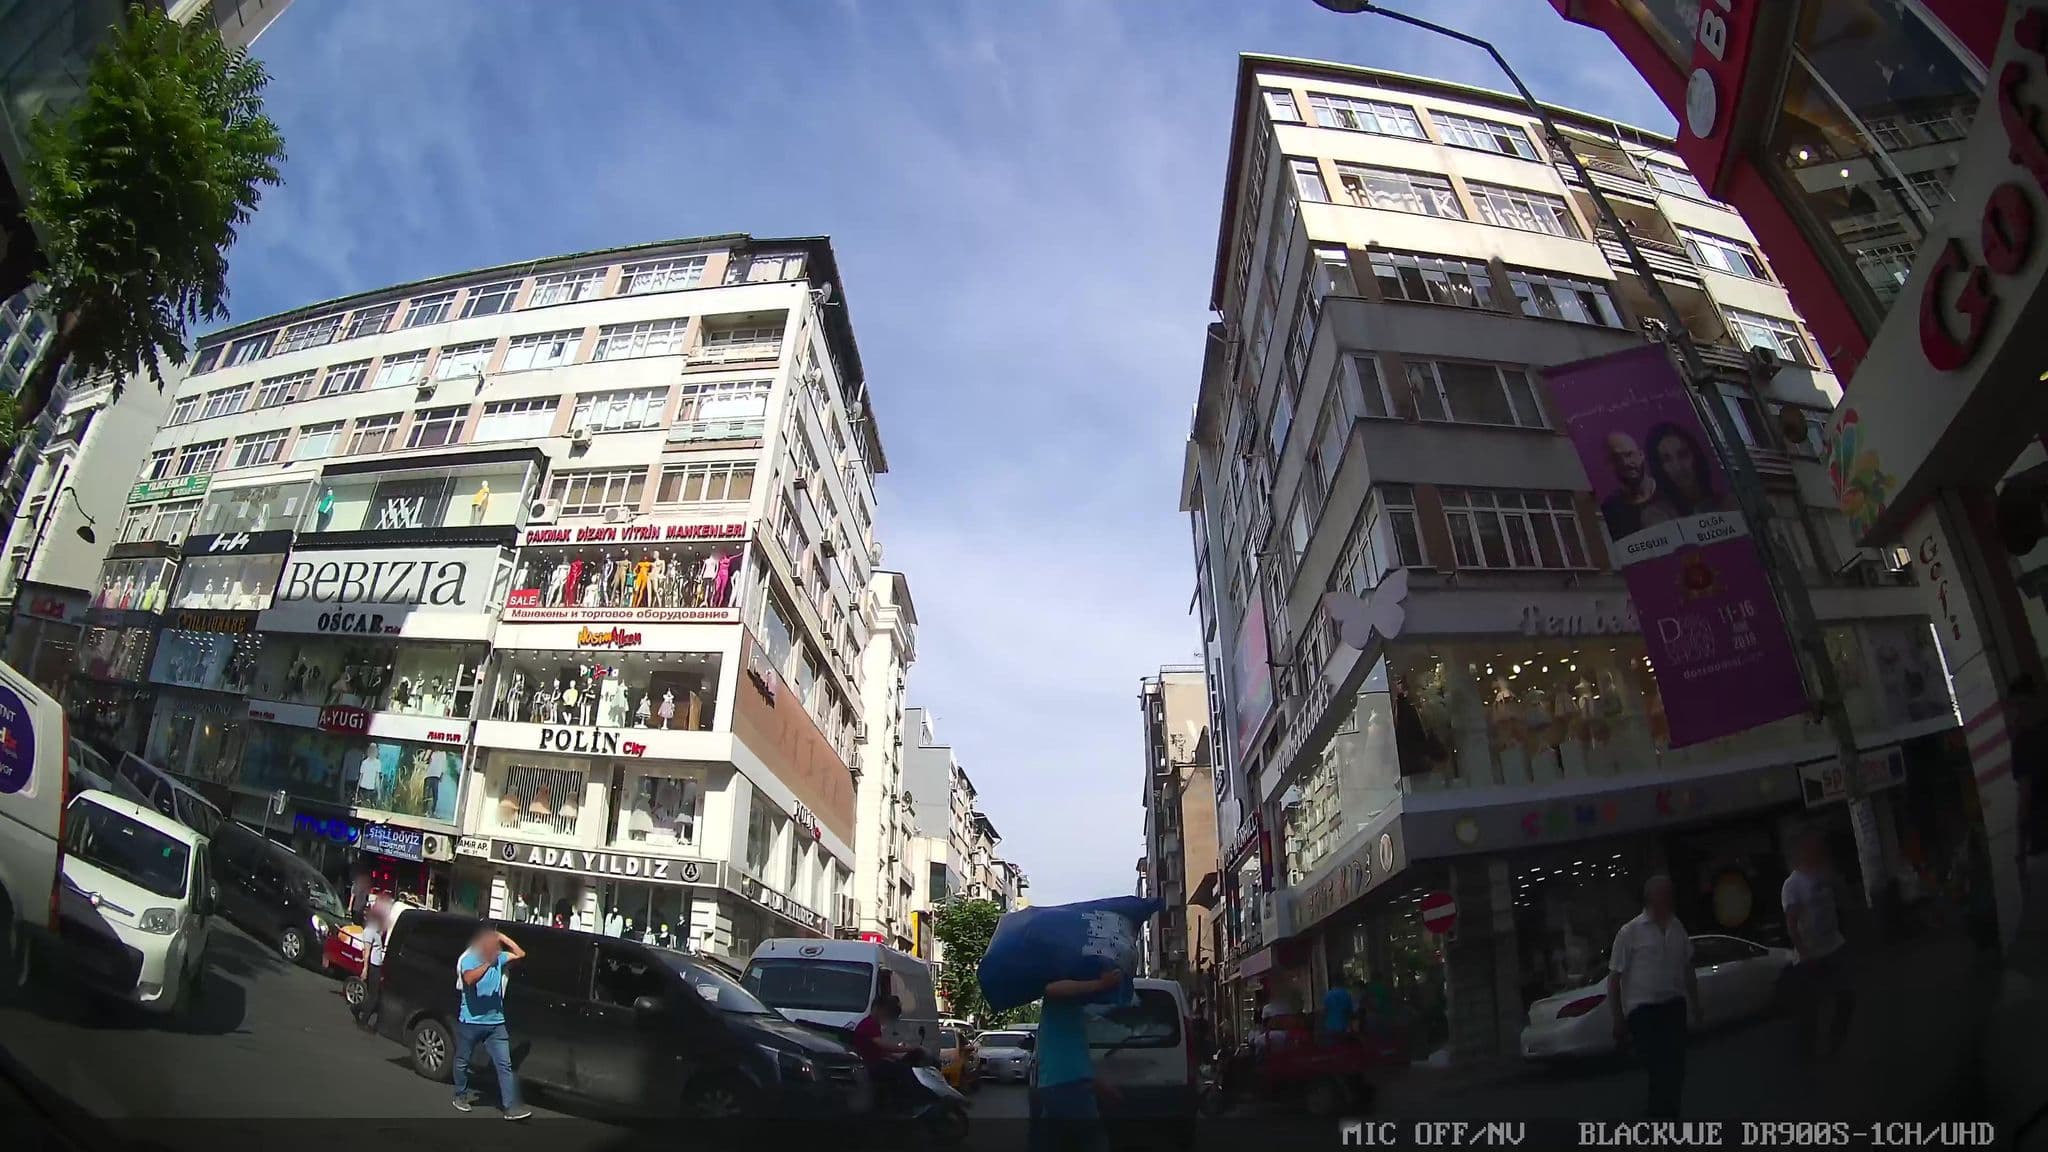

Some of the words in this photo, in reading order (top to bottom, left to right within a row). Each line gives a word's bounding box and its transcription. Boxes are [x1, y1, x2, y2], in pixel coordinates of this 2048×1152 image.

[621, 524, 660, 540] VİTRİN
[509, 596, 537, 606] SALE
[511, 610, 568, 619] Манекены
[581, 611, 633, 620] торговое
[636, 609, 729, 620] оборудование
[527, 846, 575, 870] ADA
